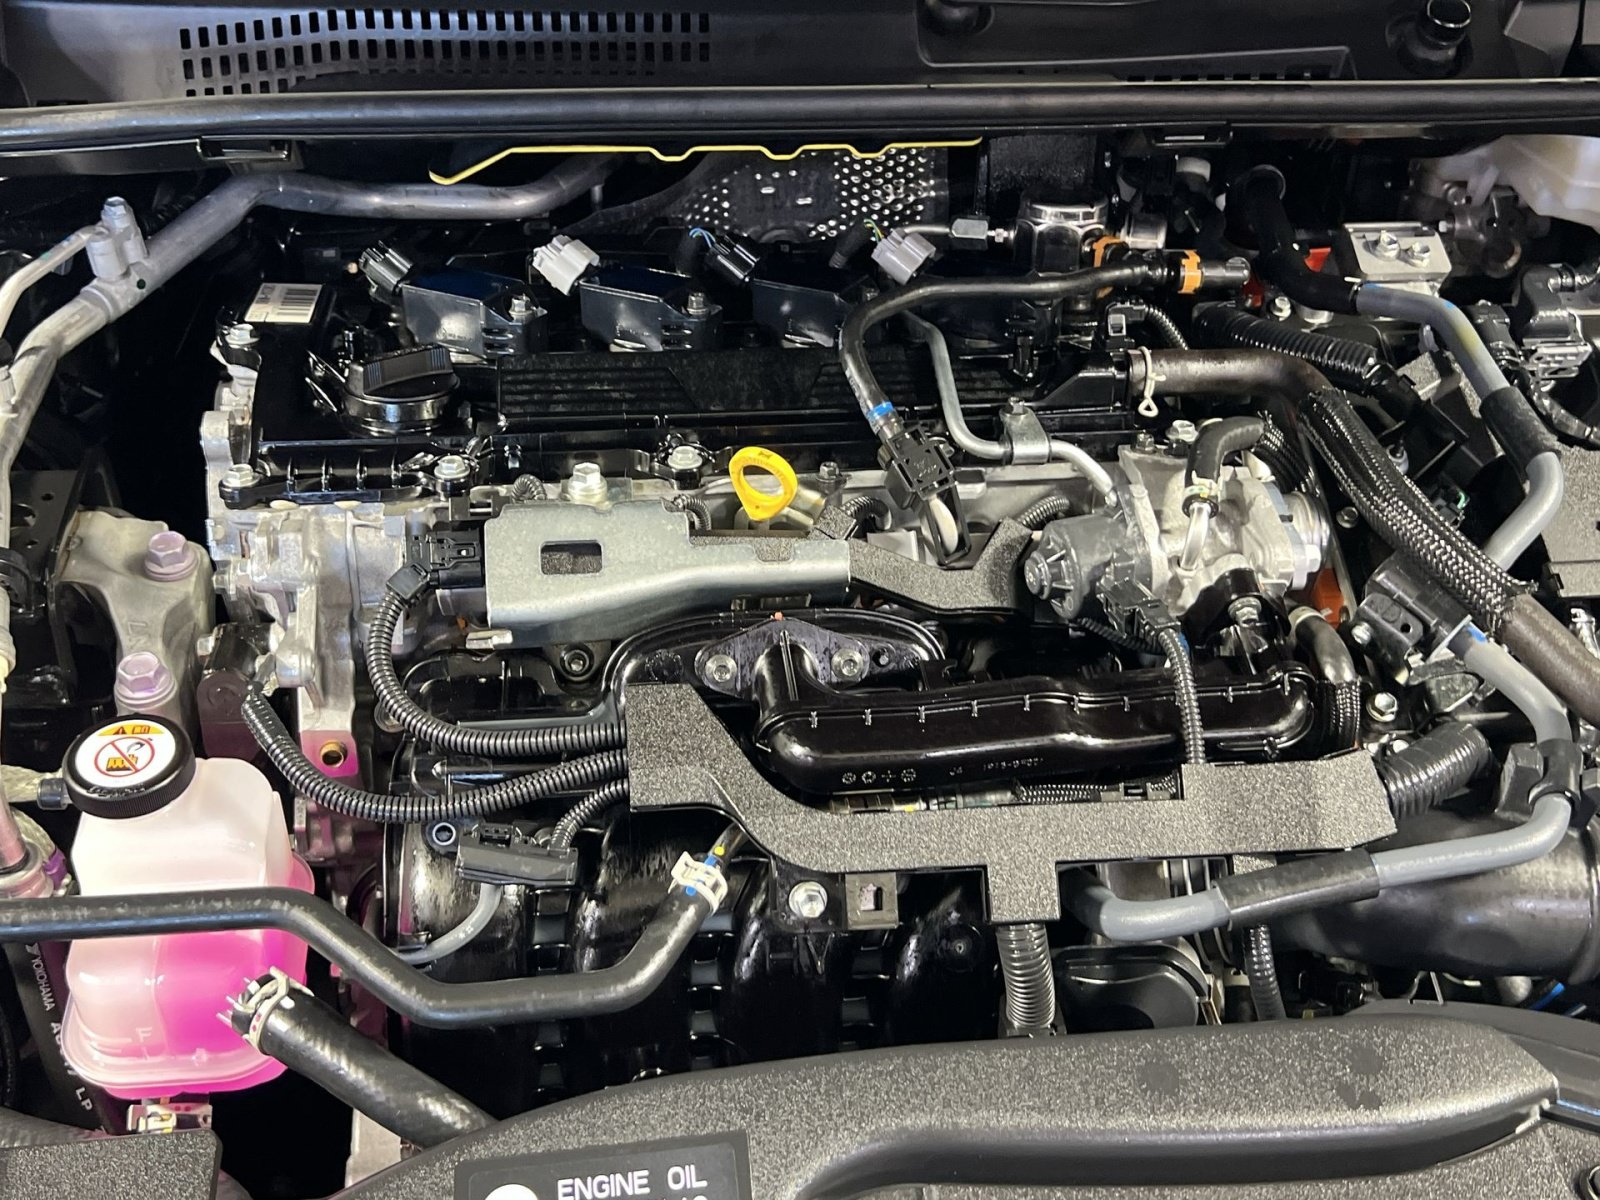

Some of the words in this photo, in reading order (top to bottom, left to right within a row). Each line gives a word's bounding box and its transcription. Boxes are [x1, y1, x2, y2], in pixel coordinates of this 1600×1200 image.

[32, 958, 56, 1011] YOKOHAMA
[75, 1087, 93, 1111] LP
[136, 1027, 152, 1043] F
[557, 1170, 650, 1200] ENGINE
[667, 1164, 708, 1190] OIL
